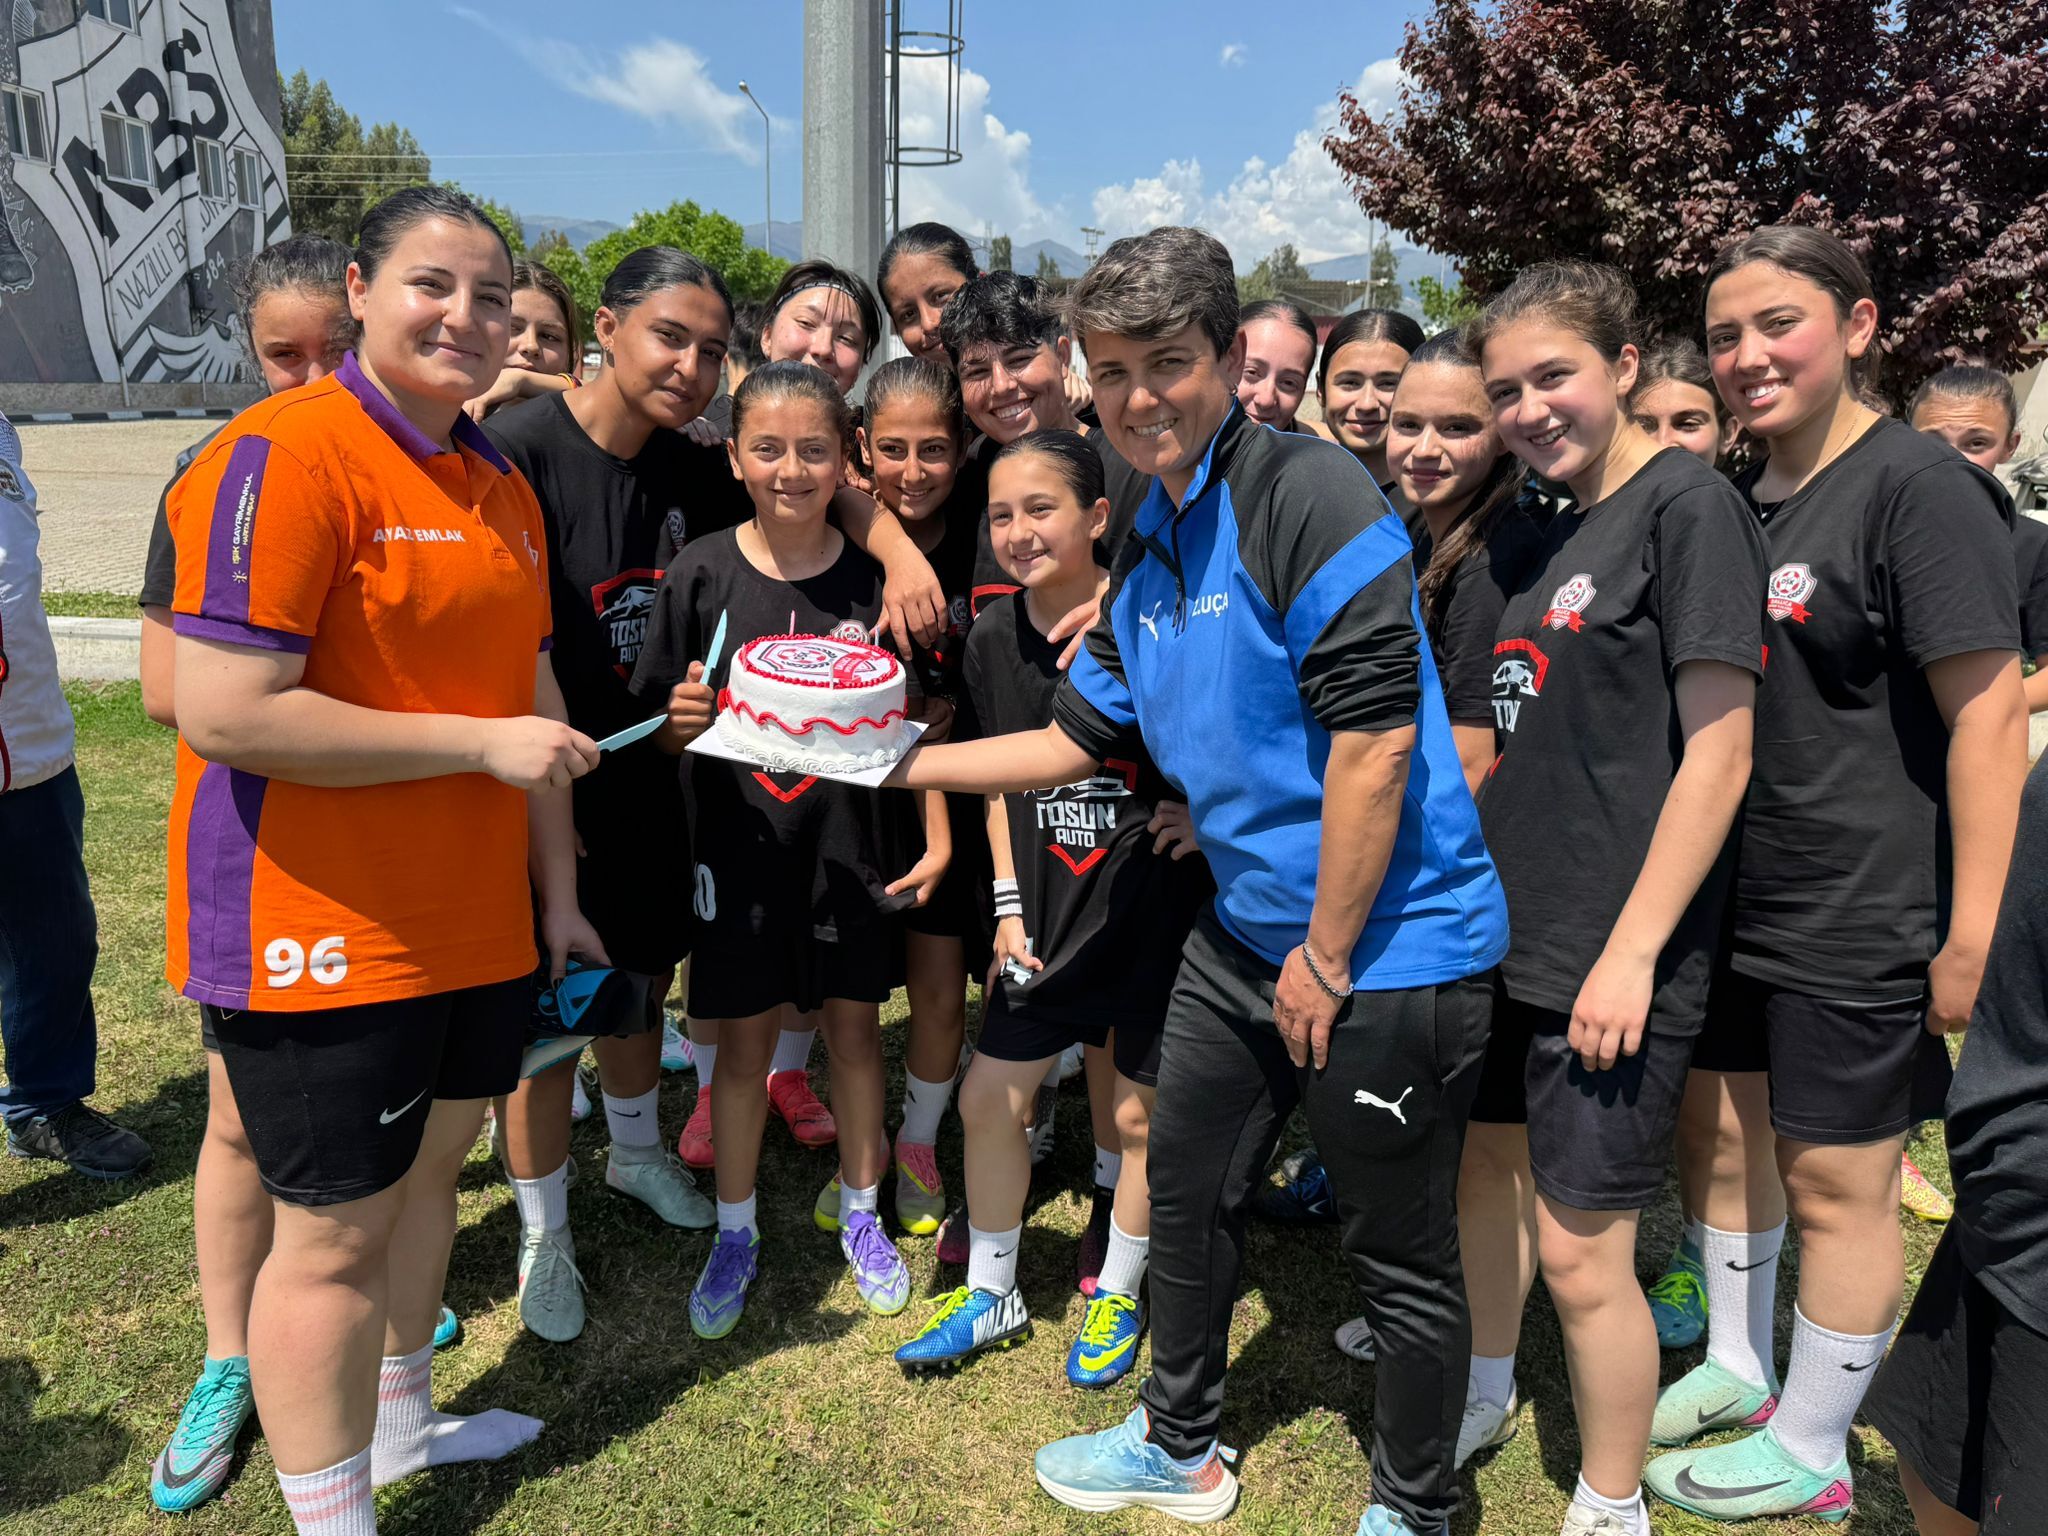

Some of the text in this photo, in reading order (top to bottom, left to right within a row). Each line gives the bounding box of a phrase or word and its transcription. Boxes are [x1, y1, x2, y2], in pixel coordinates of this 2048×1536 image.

[414, 528, 466, 542] EMLAK
[610, 617, 647, 649] TOS
[1036, 801, 1116, 830] TOSUN
[1055, 828, 1096, 848] AUTO
[264, 935, 348, 988] 96
